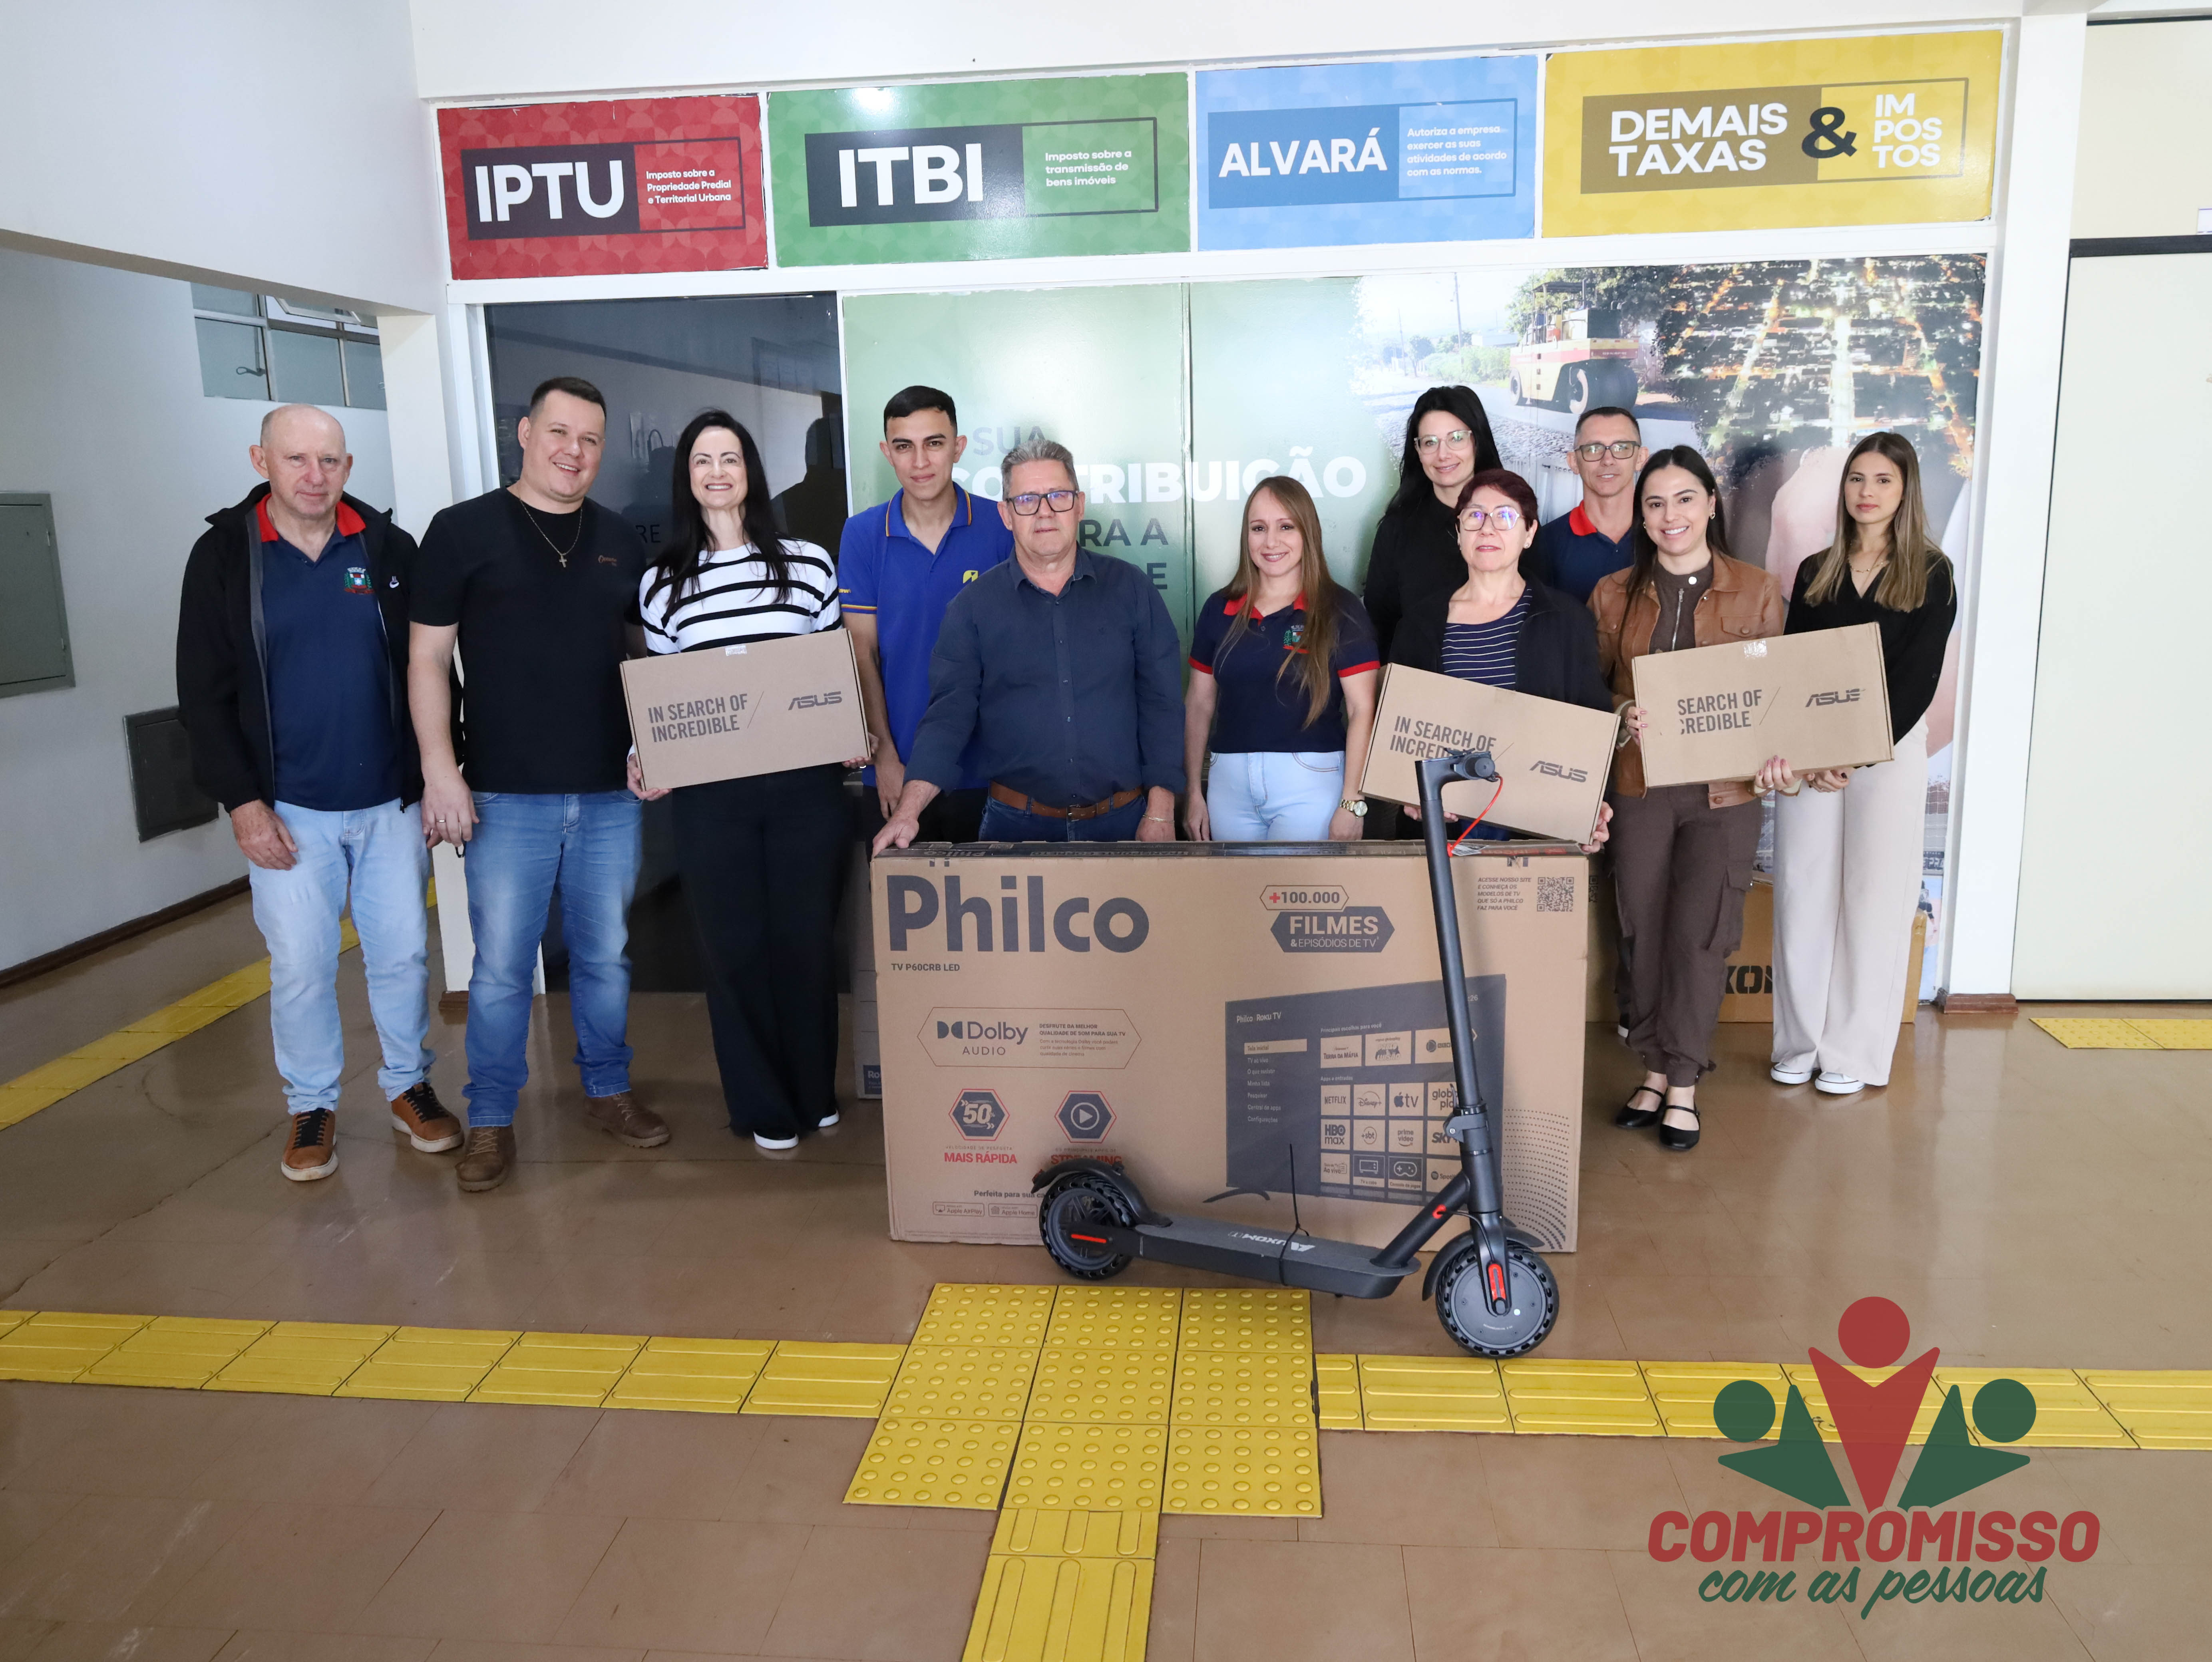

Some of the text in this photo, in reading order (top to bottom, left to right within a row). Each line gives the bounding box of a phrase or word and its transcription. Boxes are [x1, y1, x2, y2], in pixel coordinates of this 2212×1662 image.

[1875, 93, 1915, 117] IM
[1407, 127, 1447, 137] Autoriza
[1458, 126, 1500, 136] empresa
[1610, 103, 1787, 142] DEMAIS
[1801, 107, 1858, 158] &
[1873, 117, 1942, 143] POS
[1219, 127, 1387, 178] ALVARÁ
[1407, 141, 1443, 150] exercer
[1872, 143, 1940, 168] TOS
[1045, 152, 1090, 163] Imposto
[1092, 150, 1122, 159] sobre
[1407, 151, 1507, 163] atividades de acordo
[1609, 138, 1766, 176] TAXAS
[646, 171, 682, 181] Imposto
[839, 143, 983, 207] ITBI
[1045, 162, 1128, 173] transmissão de
[1443, 167, 1482, 175] normas.
[475, 160, 625, 222] IPTU
[647, 180, 731, 193] Propriedade Predial
[1046, 175, 1116, 187] bens imóveis
[654, 194, 697, 203] Territorial
[1079, 518, 1168, 547] RA A
[648, 693, 748, 724] IN SEARCH OF
[788, 691, 842, 710] ASUS
[1678, 689, 1762, 716] SEARCH OF
[652, 715, 740, 743] INCREDIBLE
[1394, 716, 1497, 752] IN SEARCH OF
[1529, 760, 1588, 783] ASUS
[886, 875, 1149, 953] Philco
[1290, 916, 1378, 934] FILMES
[1237, 1011, 1282, 1023] Philco TV
[968, 1022, 1028, 1045] Dolby
[963, 1046, 1005, 1055] AUDIO
[1325, 1096, 1346, 1104] NETFLIX
[1325, 1124, 1346, 1136] HBO
[944, 1151, 1017, 1163] MAIS RÁPIDA
